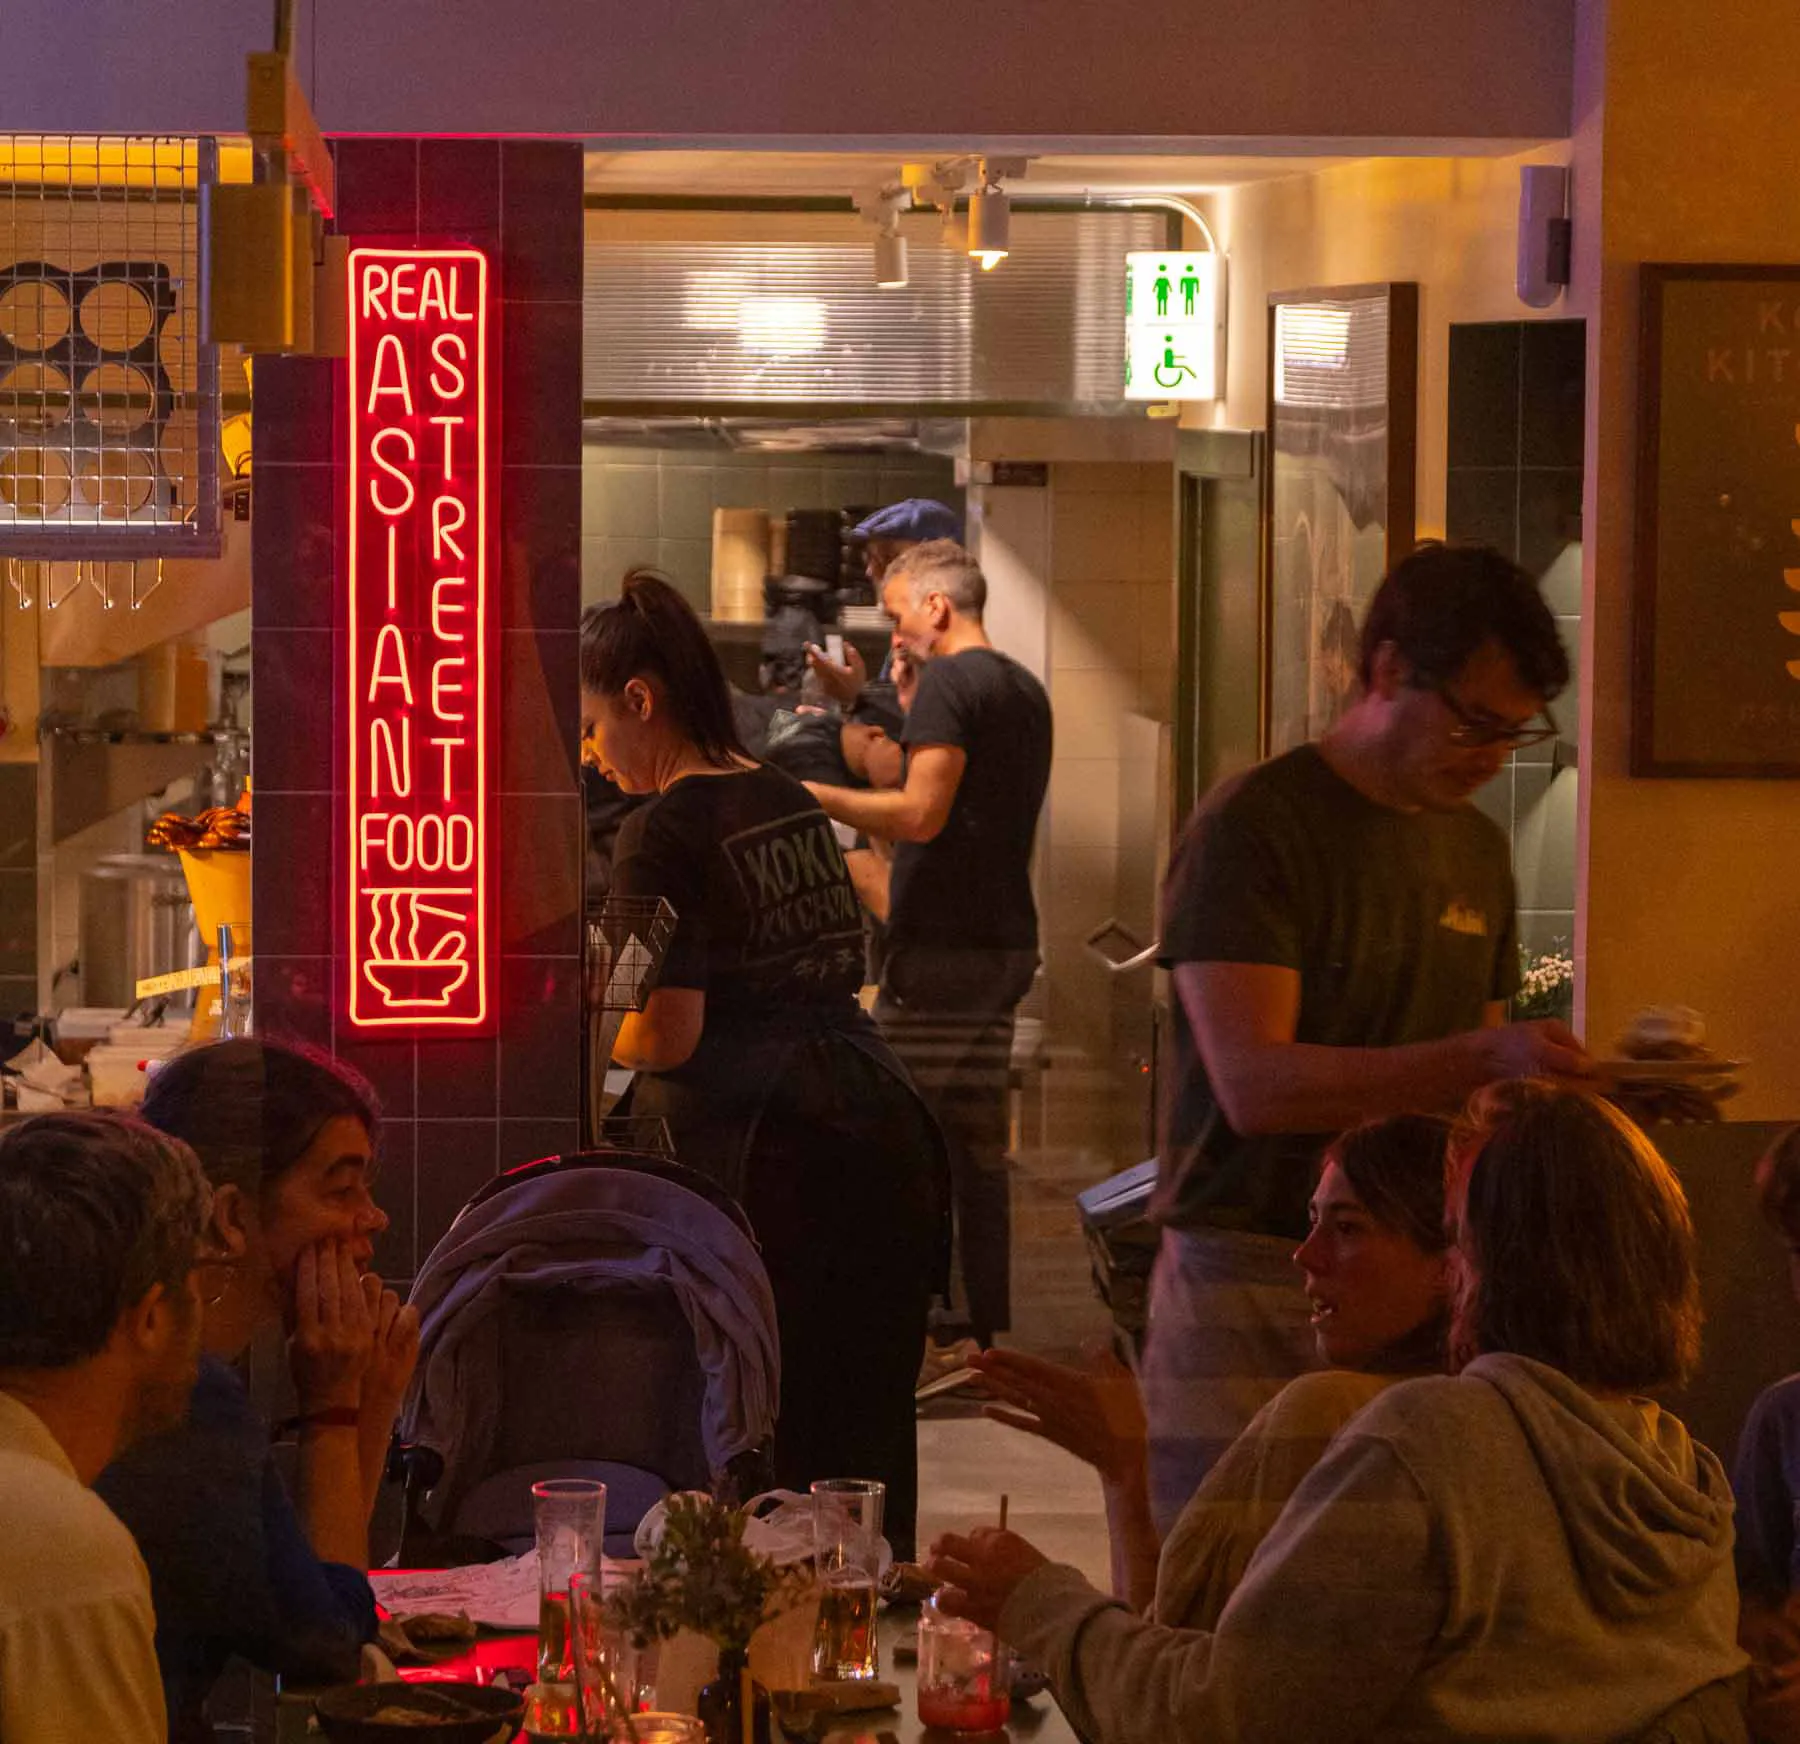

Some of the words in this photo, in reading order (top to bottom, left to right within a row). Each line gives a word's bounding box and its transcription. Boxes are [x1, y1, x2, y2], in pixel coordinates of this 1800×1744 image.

[363, 263, 474, 320] REAL
[1706, 348, 1800, 384] KIT
[368, 334, 416, 798] ASIAN
[429, 333, 466, 802] STREET
[361, 813, 474, 871] FOOD
